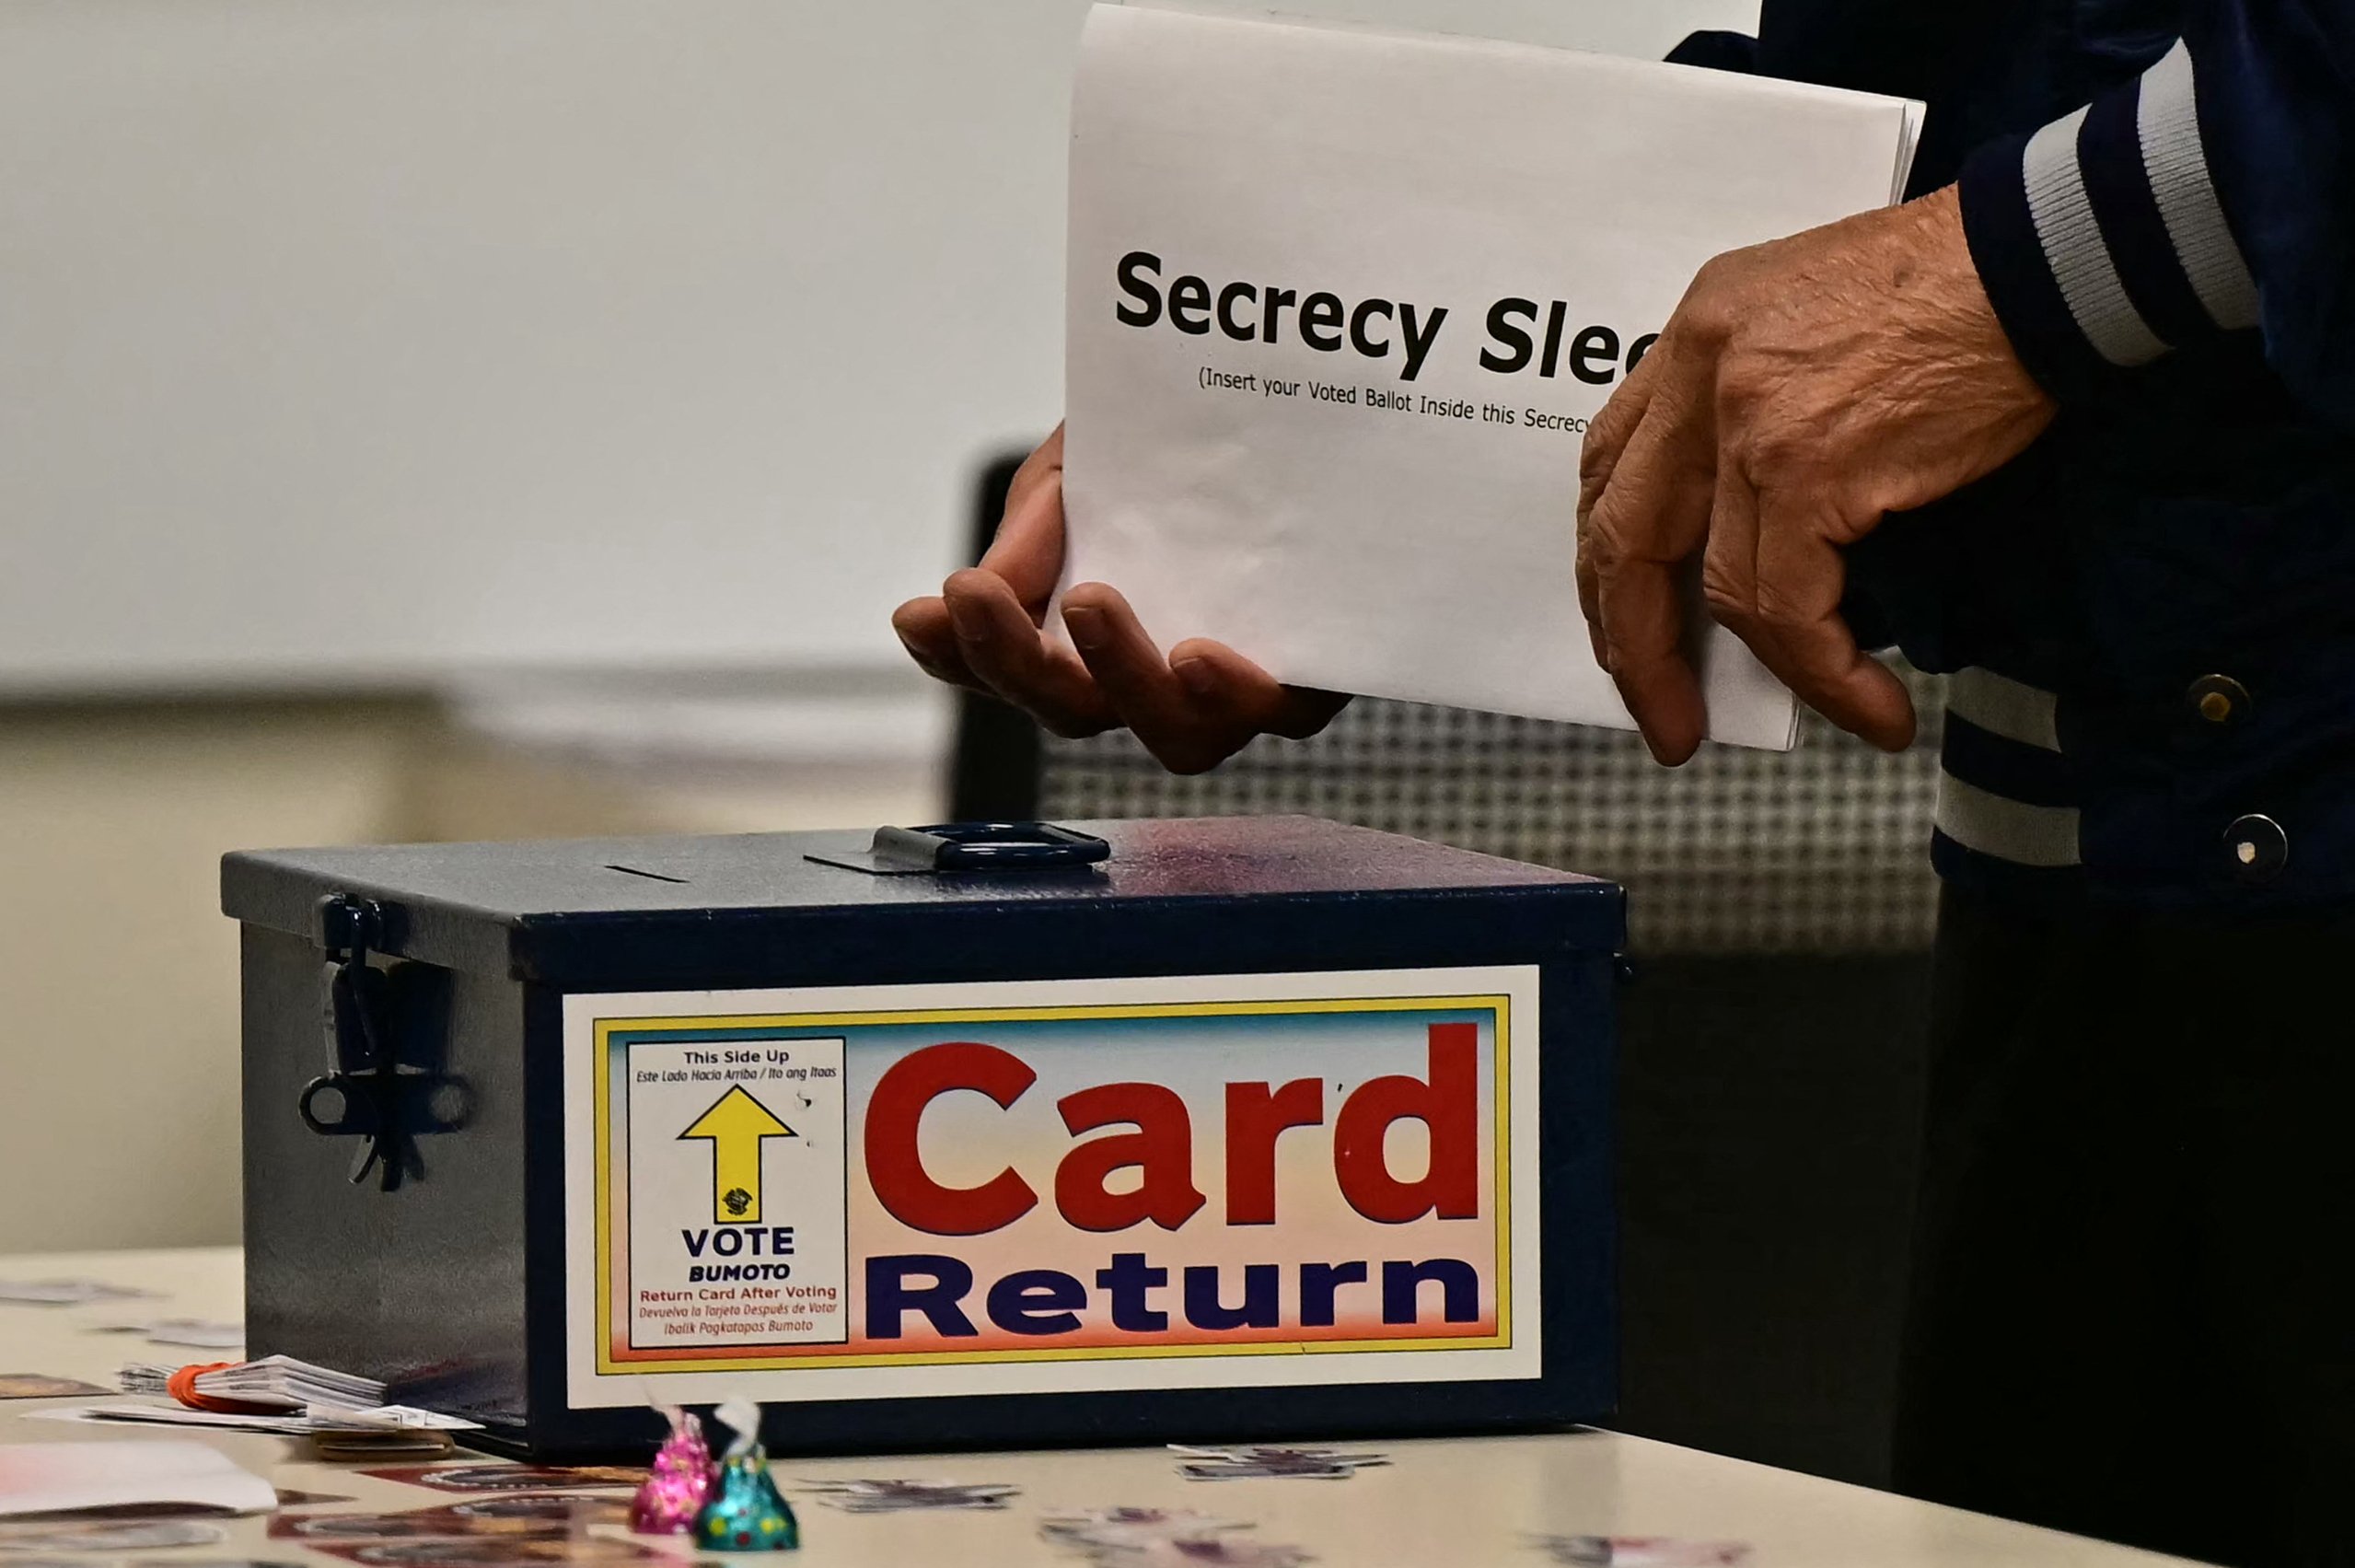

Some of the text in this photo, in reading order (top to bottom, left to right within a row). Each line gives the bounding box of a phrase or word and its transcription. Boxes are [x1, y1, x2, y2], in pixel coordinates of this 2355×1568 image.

[1115, 250, 1449, 381] Secrecy
[1199, 366, 1257, 391] (Insert
[1263, 378, 1301, 397] your
[1308, 380, 1356, 403] Voted
[1365, 388, 1412, 412] Ballot
[1421, 395, 1474, 420] Inside
[1482, 403, 1515, 424] this
[684, 1050, 789, 1064] This Side Up
[637, 1072, 658, 1083] Este
[662, 1070, 688, 1082] Lado
[691, 1069, 721, 1081] Hacia
[725, 1068, 757, 1080] Arriba
[769, 1067, 783, 1079] Ito
[786, 1070, 806, 1081] ang
[810, 1066, 837, 1078] Itaas
[864, 1024, 1479, 1237] Card
[681, 1226, 795, 1258] VOTE
[690, 1264, 790, 1283] BUMOTO
[641, 1286, 837, 1302] Return Card After Voting
[864, 1252, 1479, 1340] Return
[691, 1306, 702, 1317] la
[704, 1305, 740, 1318] Tarjeta
[744, 1304, 789, 1317] Después
[793, 1303, 806, 1315] de
[809, 1303, 837, 1314] Votar
[665, 1319, 814, 1336] Ibalik Pagkatapos Bumoto
